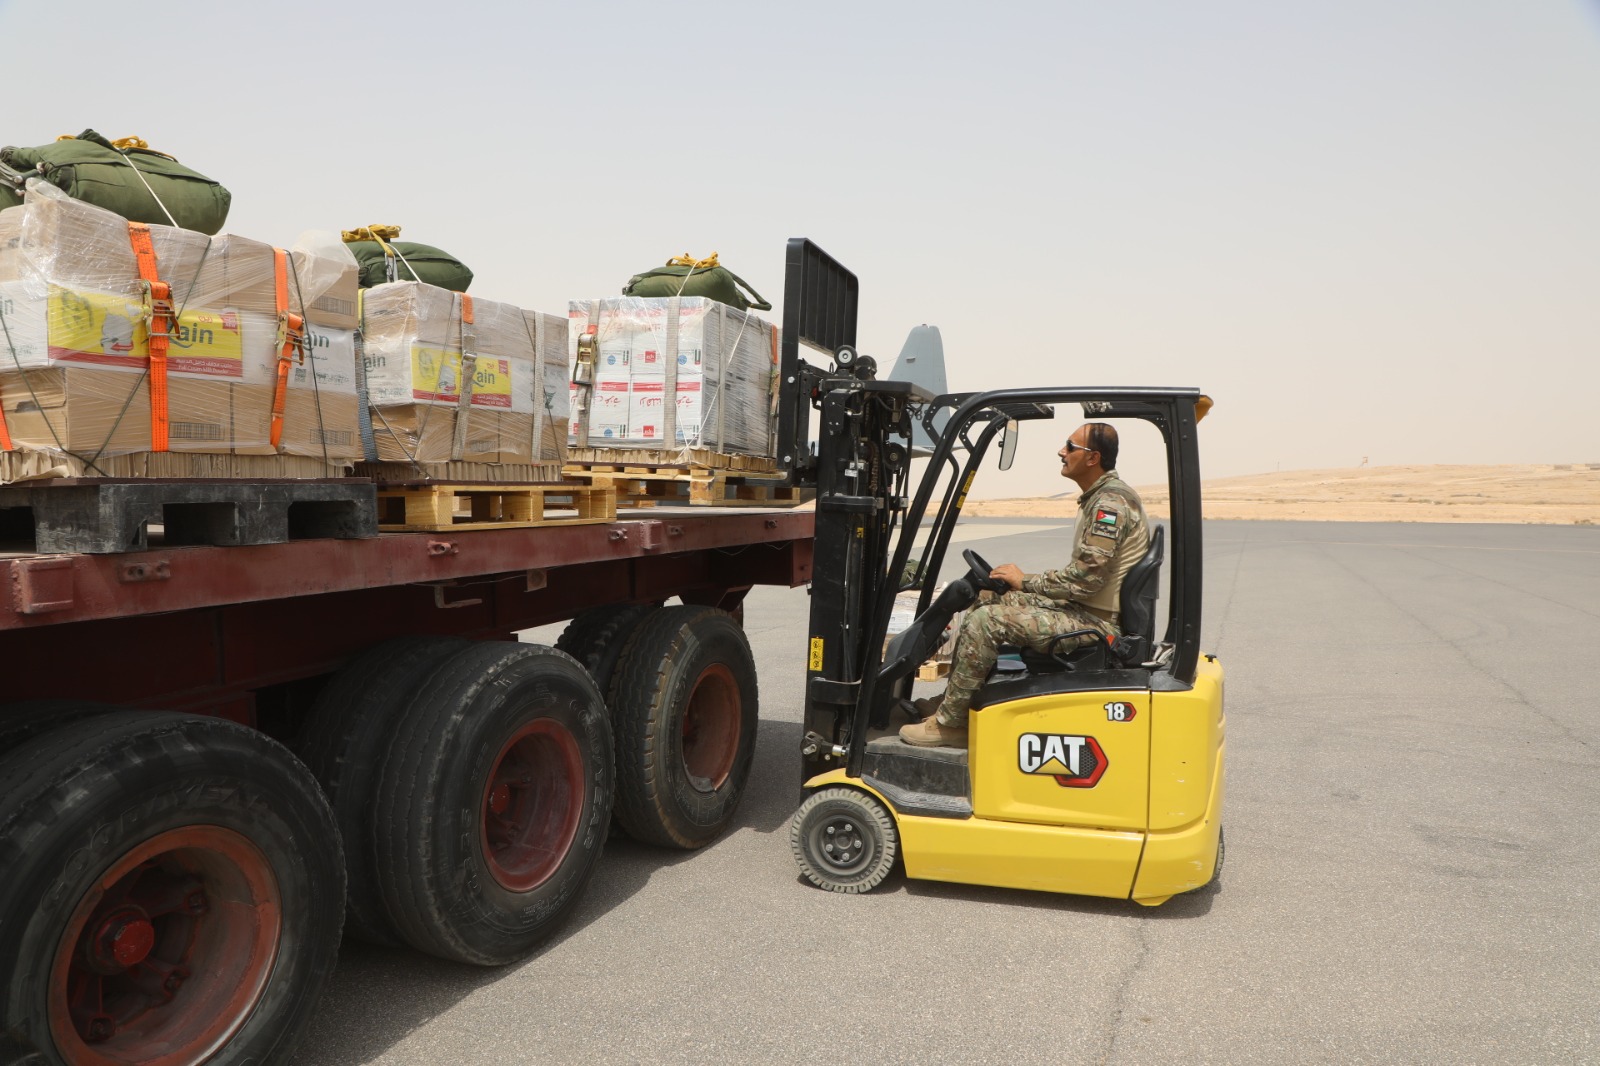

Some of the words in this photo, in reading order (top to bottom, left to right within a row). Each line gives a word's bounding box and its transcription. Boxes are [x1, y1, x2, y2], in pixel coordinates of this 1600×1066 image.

[169, 323, 214, 347] ain
[475, 369, 496, 386] ain
[1104, 702, 1125, 721] 18
[1019, 733, 1086, 776] CAT
